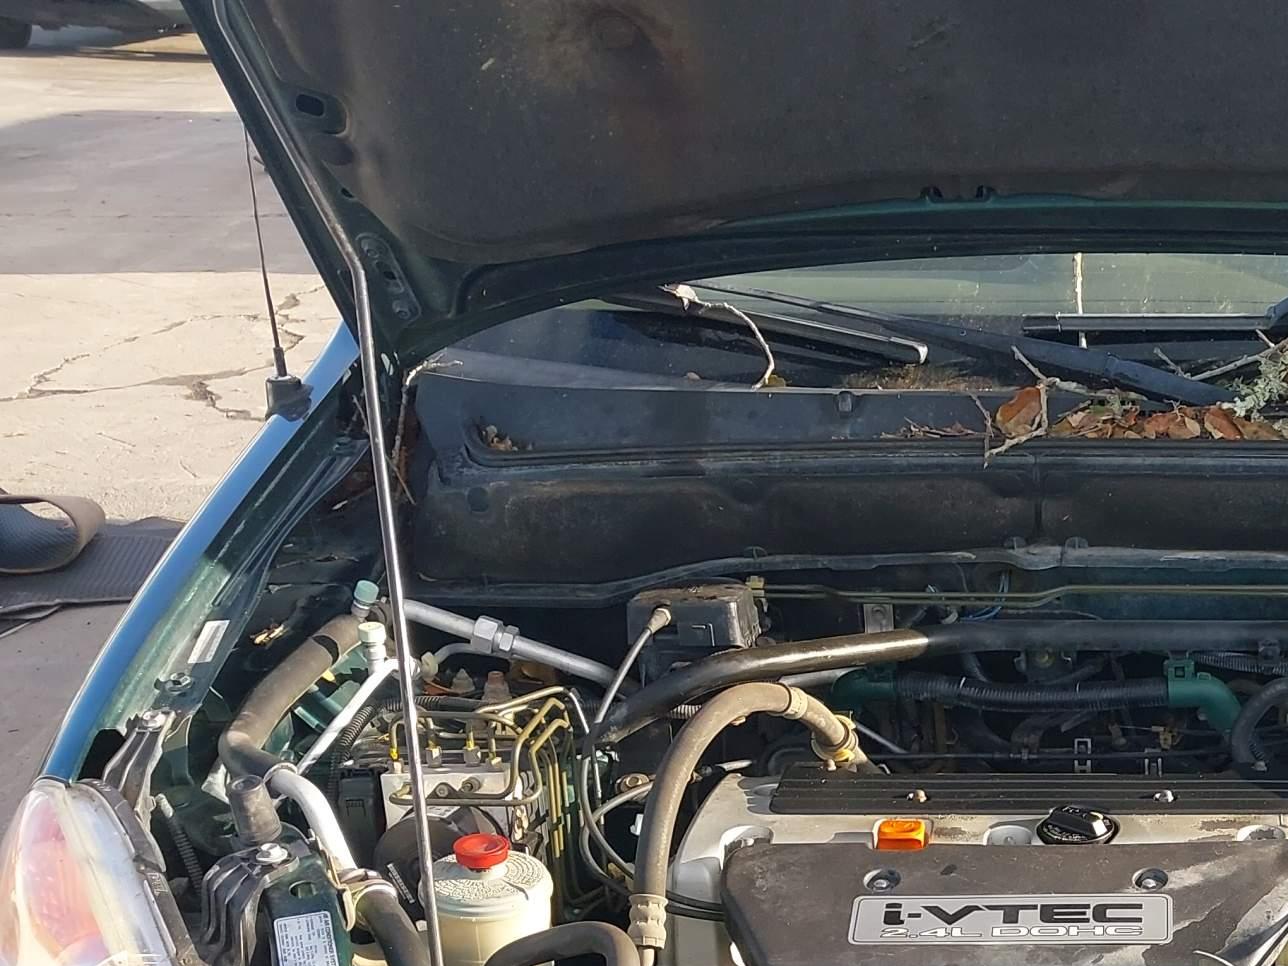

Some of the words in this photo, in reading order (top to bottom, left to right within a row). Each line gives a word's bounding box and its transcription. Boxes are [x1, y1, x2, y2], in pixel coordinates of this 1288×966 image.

[882, 902, 1143, 925] i-VTEC
[880, 926, 982, 938] 2.4L
[991, 925, 1143, 937] DOHC
